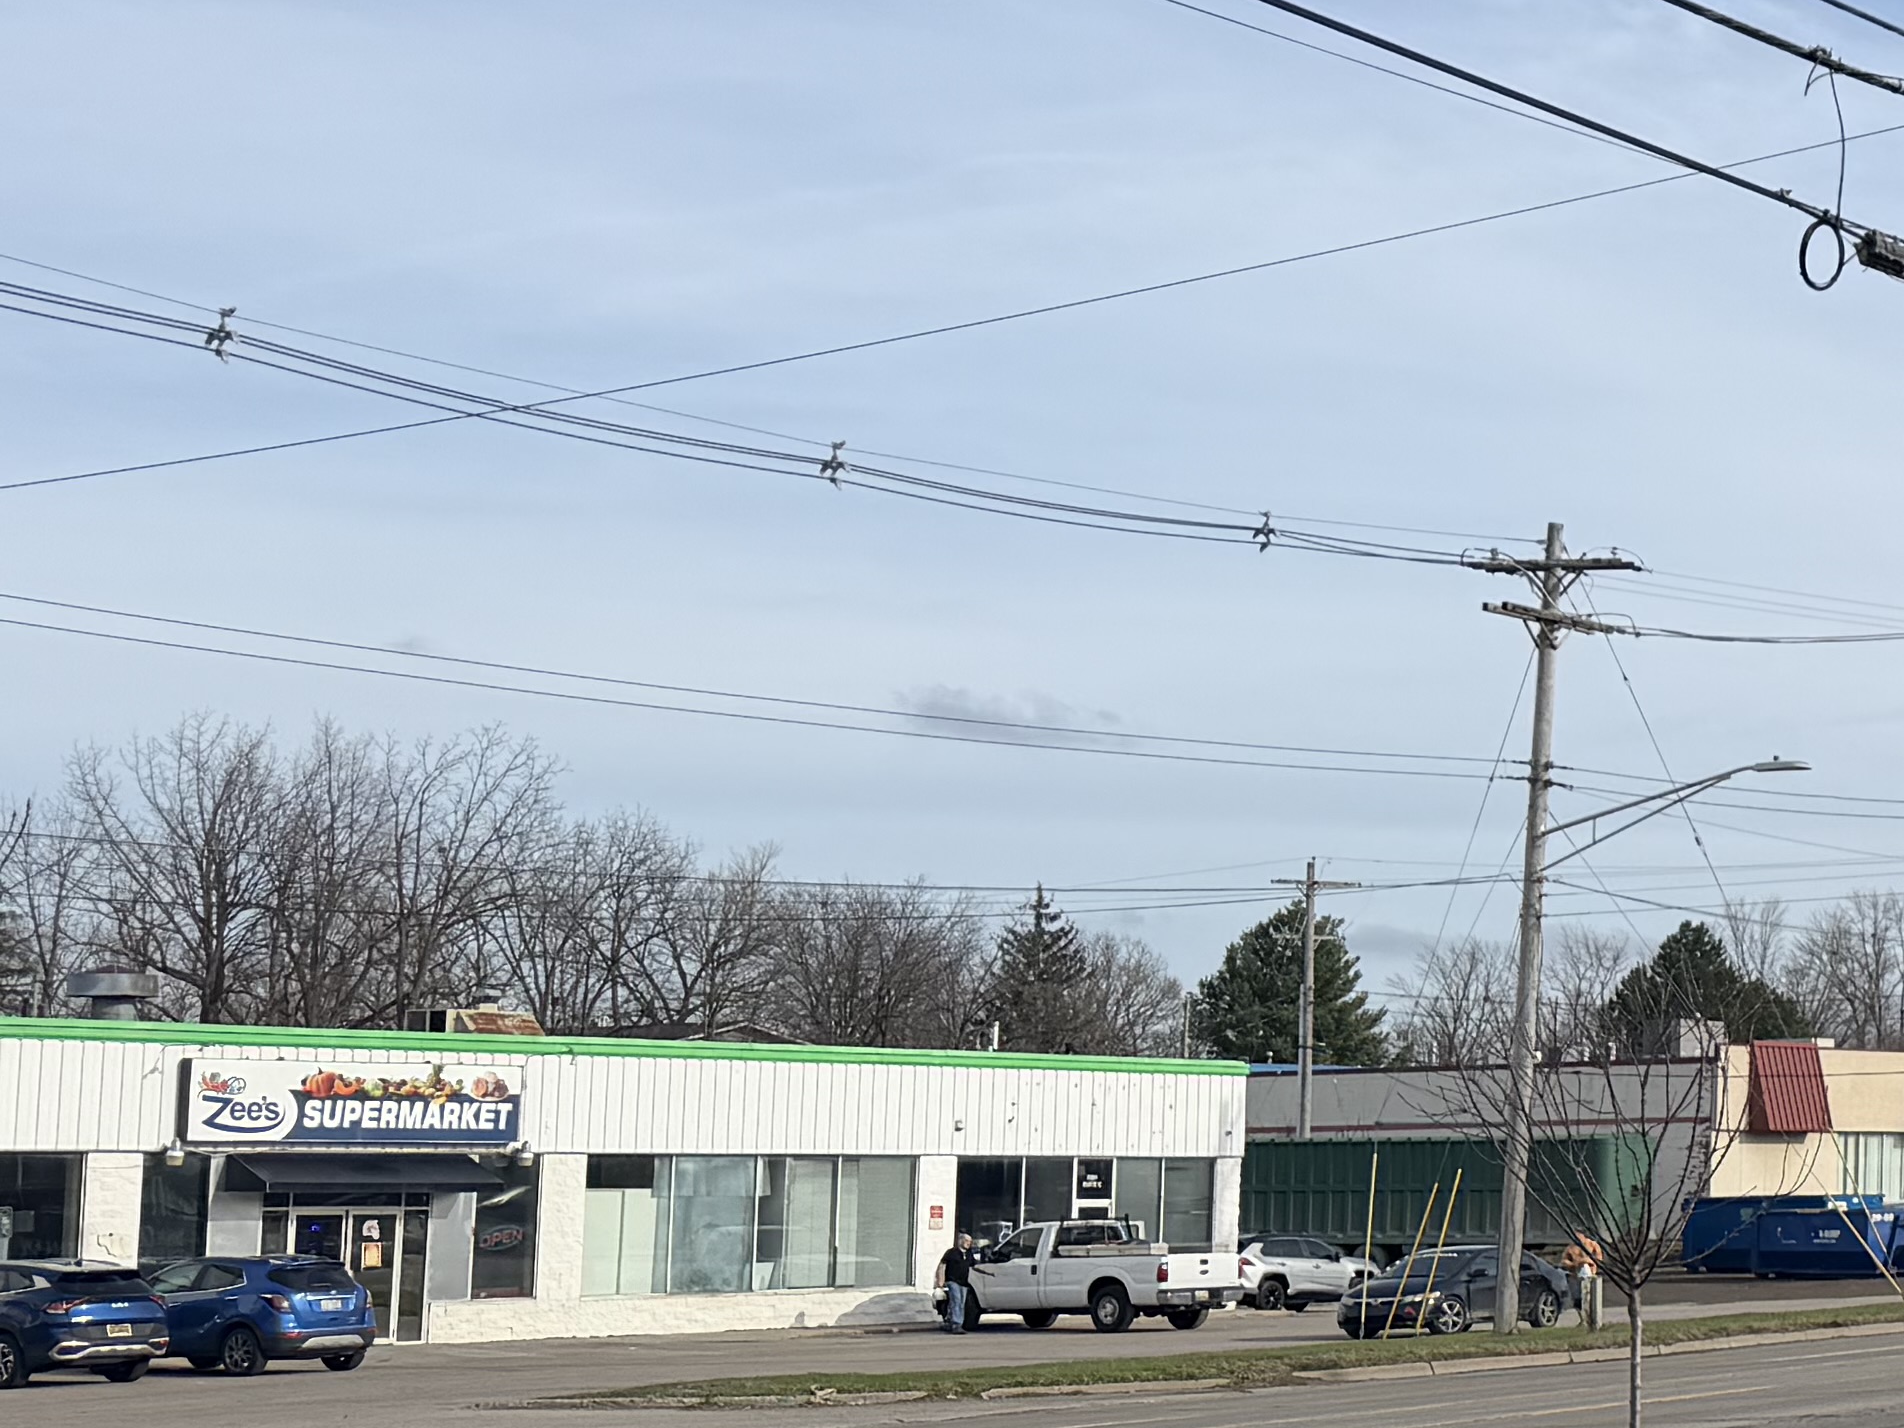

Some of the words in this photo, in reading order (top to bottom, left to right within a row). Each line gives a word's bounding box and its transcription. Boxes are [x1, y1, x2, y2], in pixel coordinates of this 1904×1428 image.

[201, 1094, 281, 1127] Zee's
[302, 1099, 514, 1131] SUPERMARKET
[478, 1228, 525, 1249] OPEN
